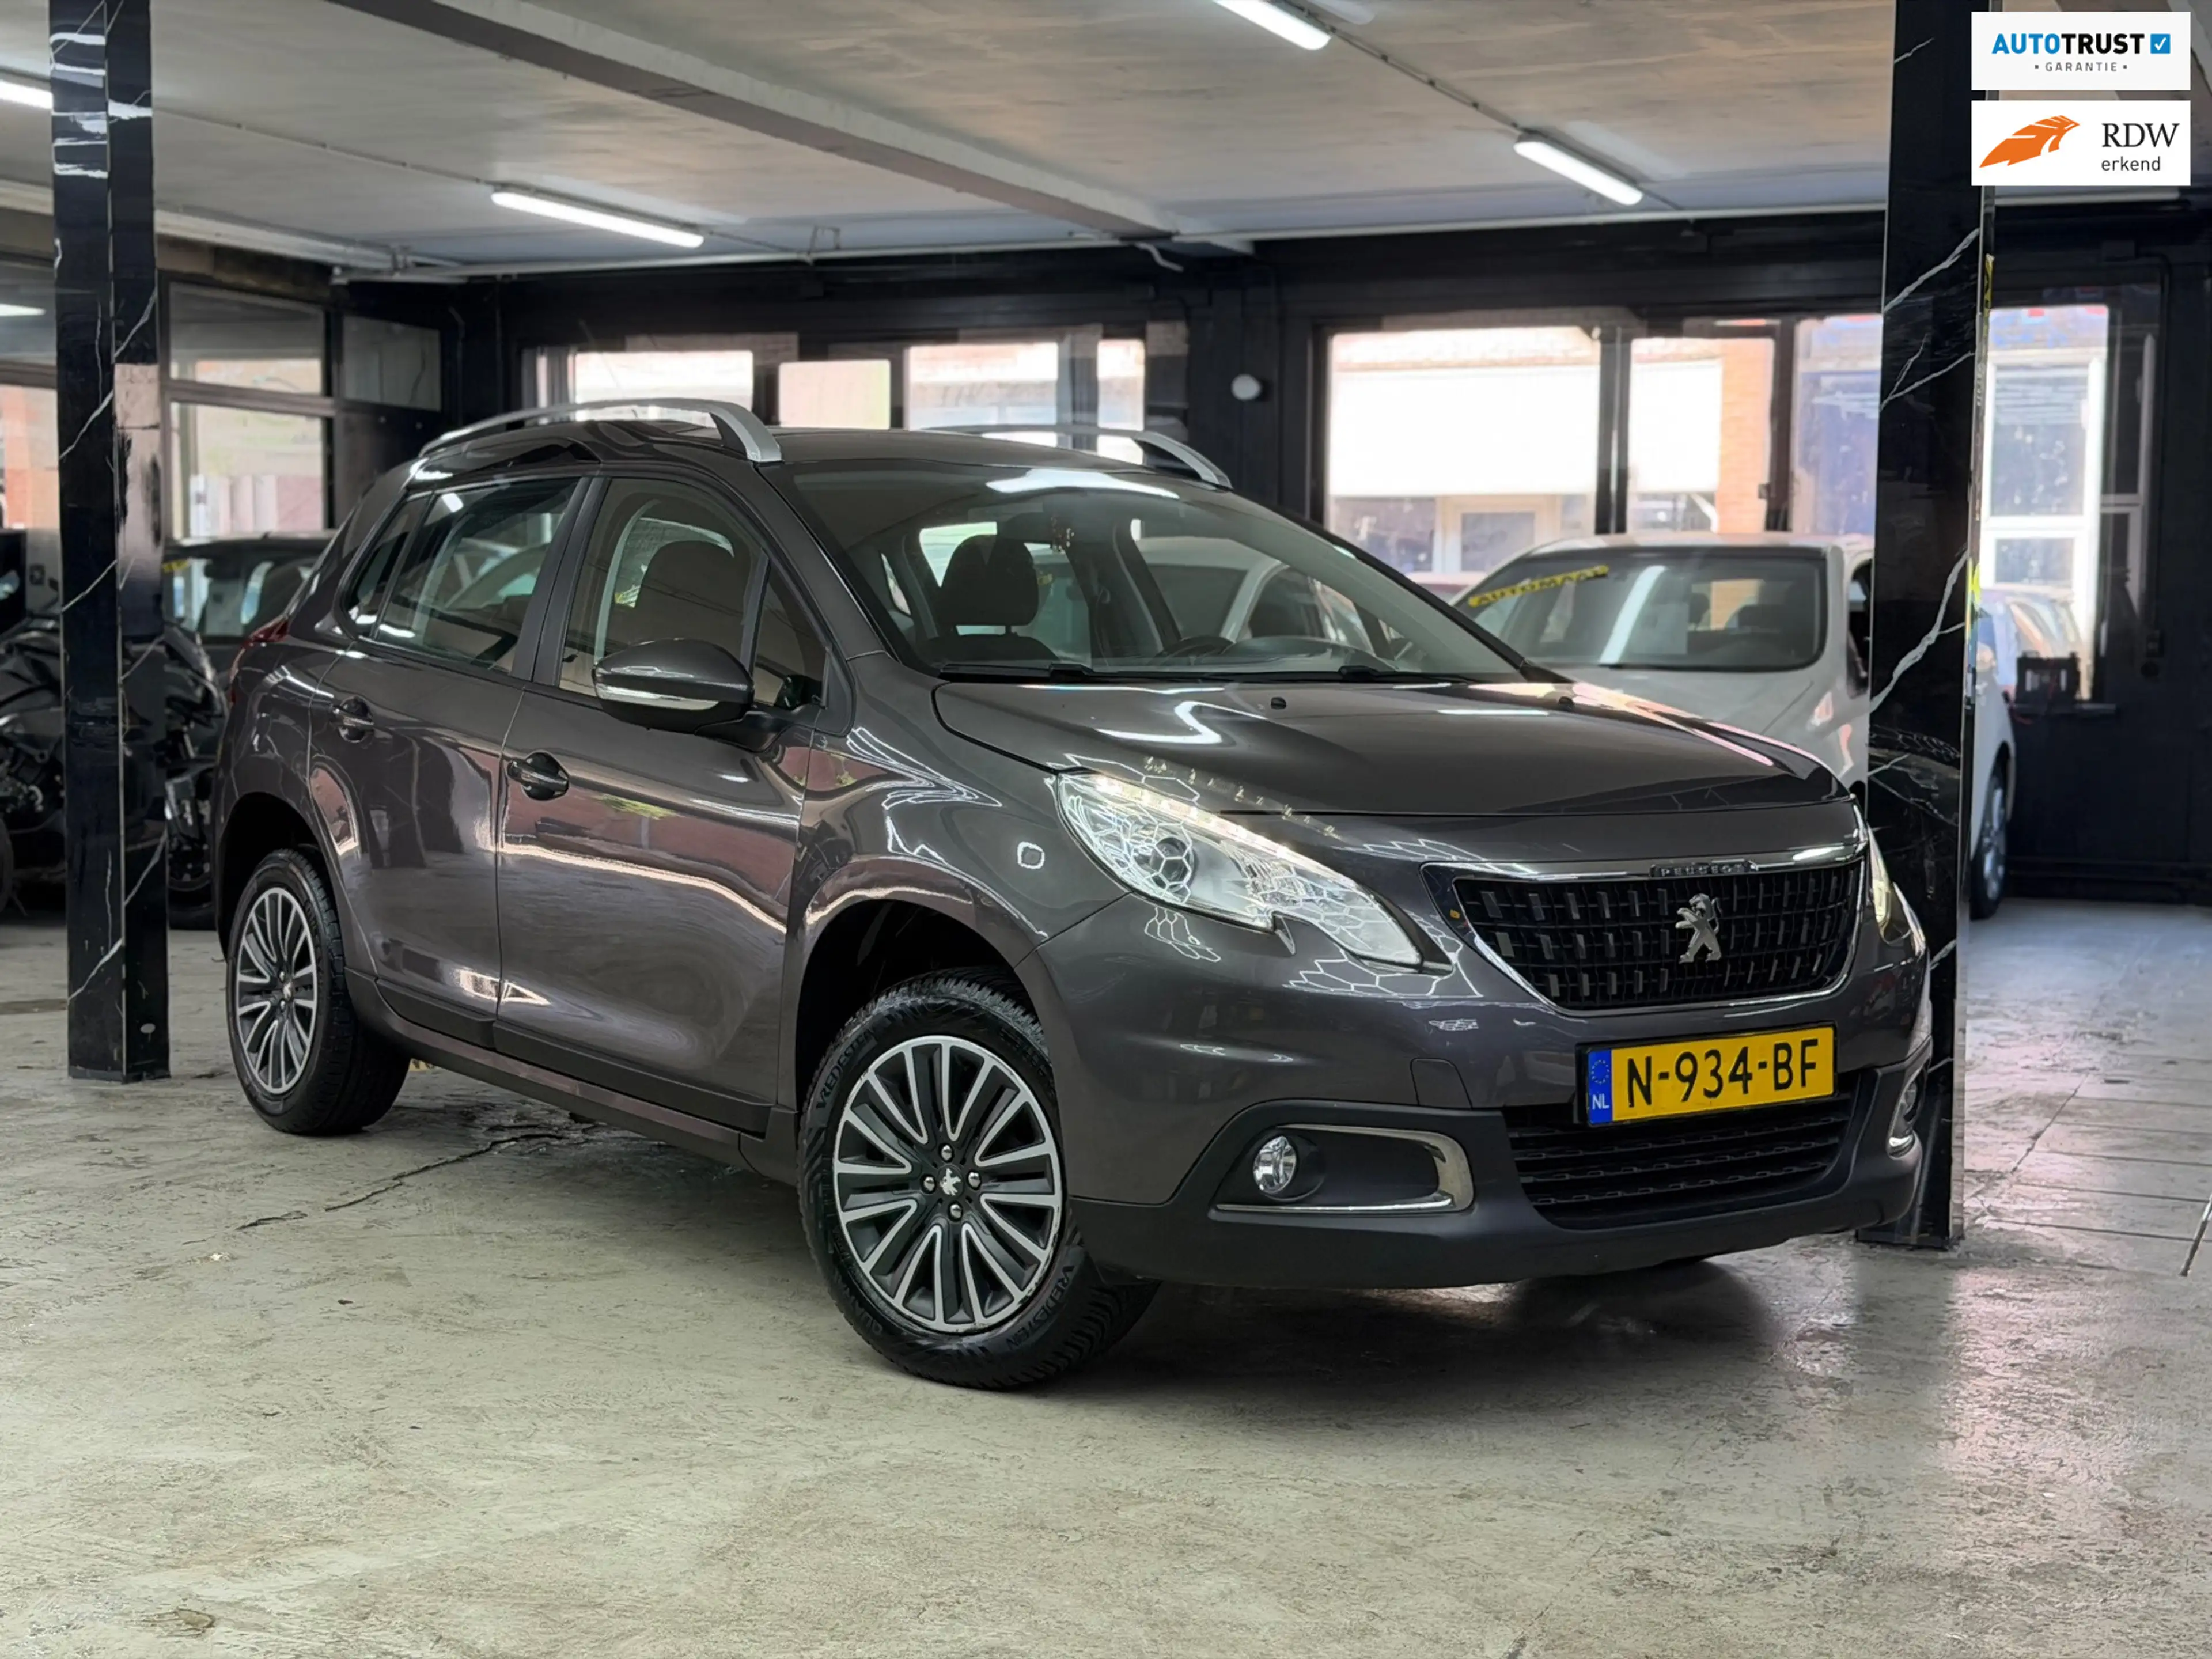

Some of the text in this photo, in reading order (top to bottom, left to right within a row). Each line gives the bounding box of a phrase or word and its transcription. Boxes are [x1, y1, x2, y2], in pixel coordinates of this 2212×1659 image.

[1661, 863, 1741, 876] PEUGEOT
[815, 1028, 876, 1109] VREDESTEN
[1627, 1039, 1819, 1108] N-934-BF
[1591, 1093, 1610, 1110] NL
